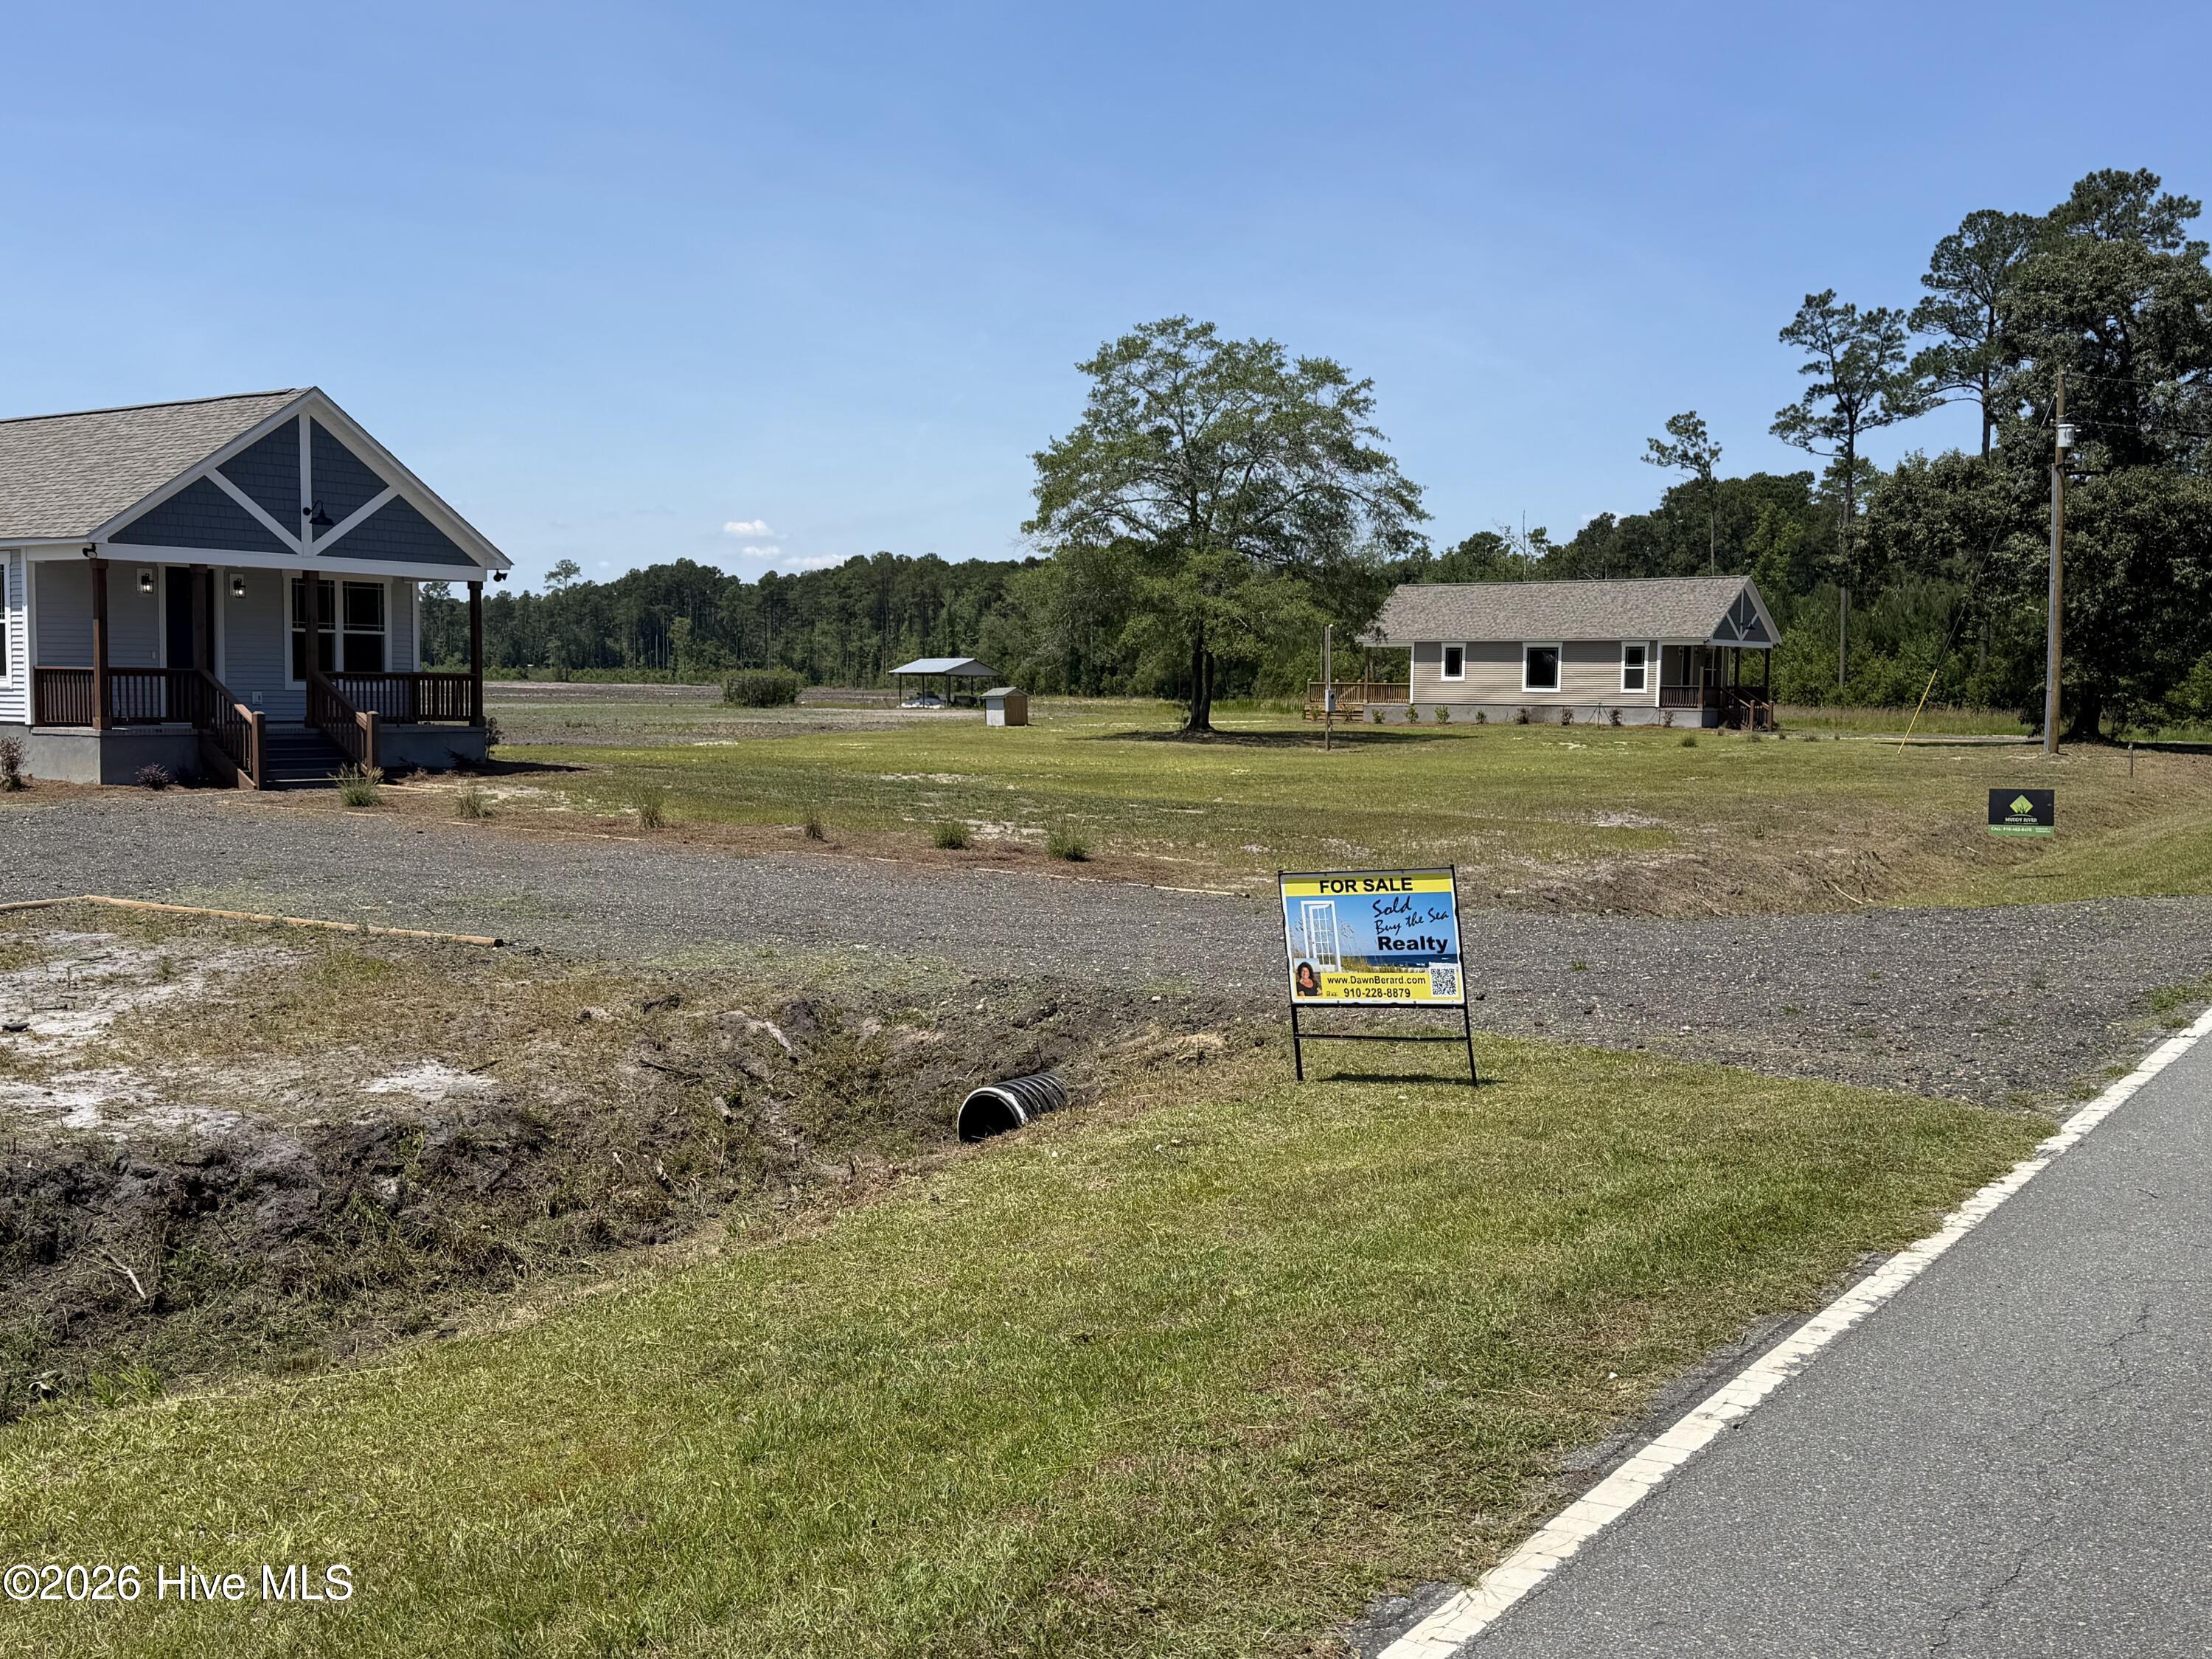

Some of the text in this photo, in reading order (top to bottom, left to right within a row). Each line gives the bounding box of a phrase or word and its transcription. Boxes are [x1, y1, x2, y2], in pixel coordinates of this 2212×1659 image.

[1319, 877, 1413, 894] FOR SALE
[1372, 896, 1412, 918] Sold
[1374, 908, 1450, 936] Buy the Sea
[1377, 936, 1448, 953] Realty
[1327, 975, 1426, 984] www.DawnBerard.com
[1343, 988, 1411, 998] 910-228-8879
